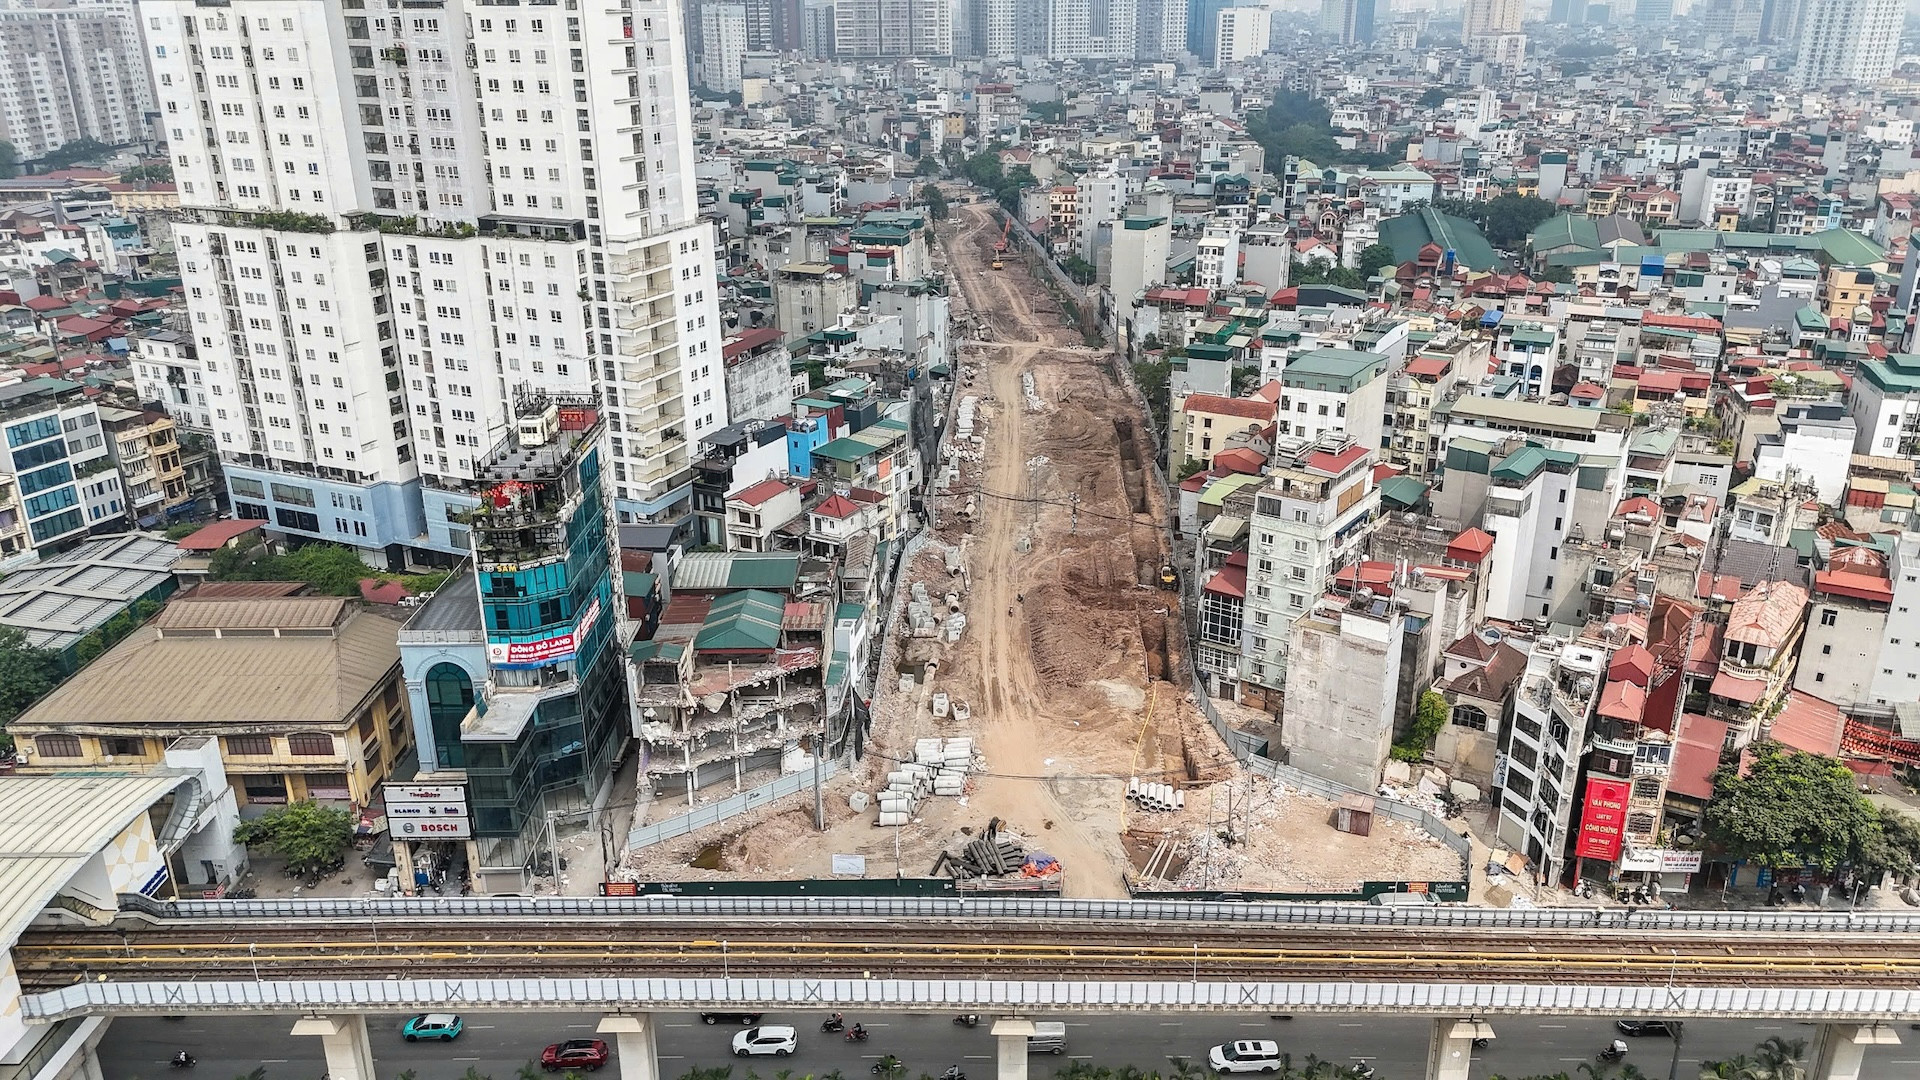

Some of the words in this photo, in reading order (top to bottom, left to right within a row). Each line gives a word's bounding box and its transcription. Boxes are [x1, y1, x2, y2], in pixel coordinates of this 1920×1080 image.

[496, 565, 518, 573] SAM
[549, 638, 571, 647] LAND
[421, 824, 458, 832] BOSCH
